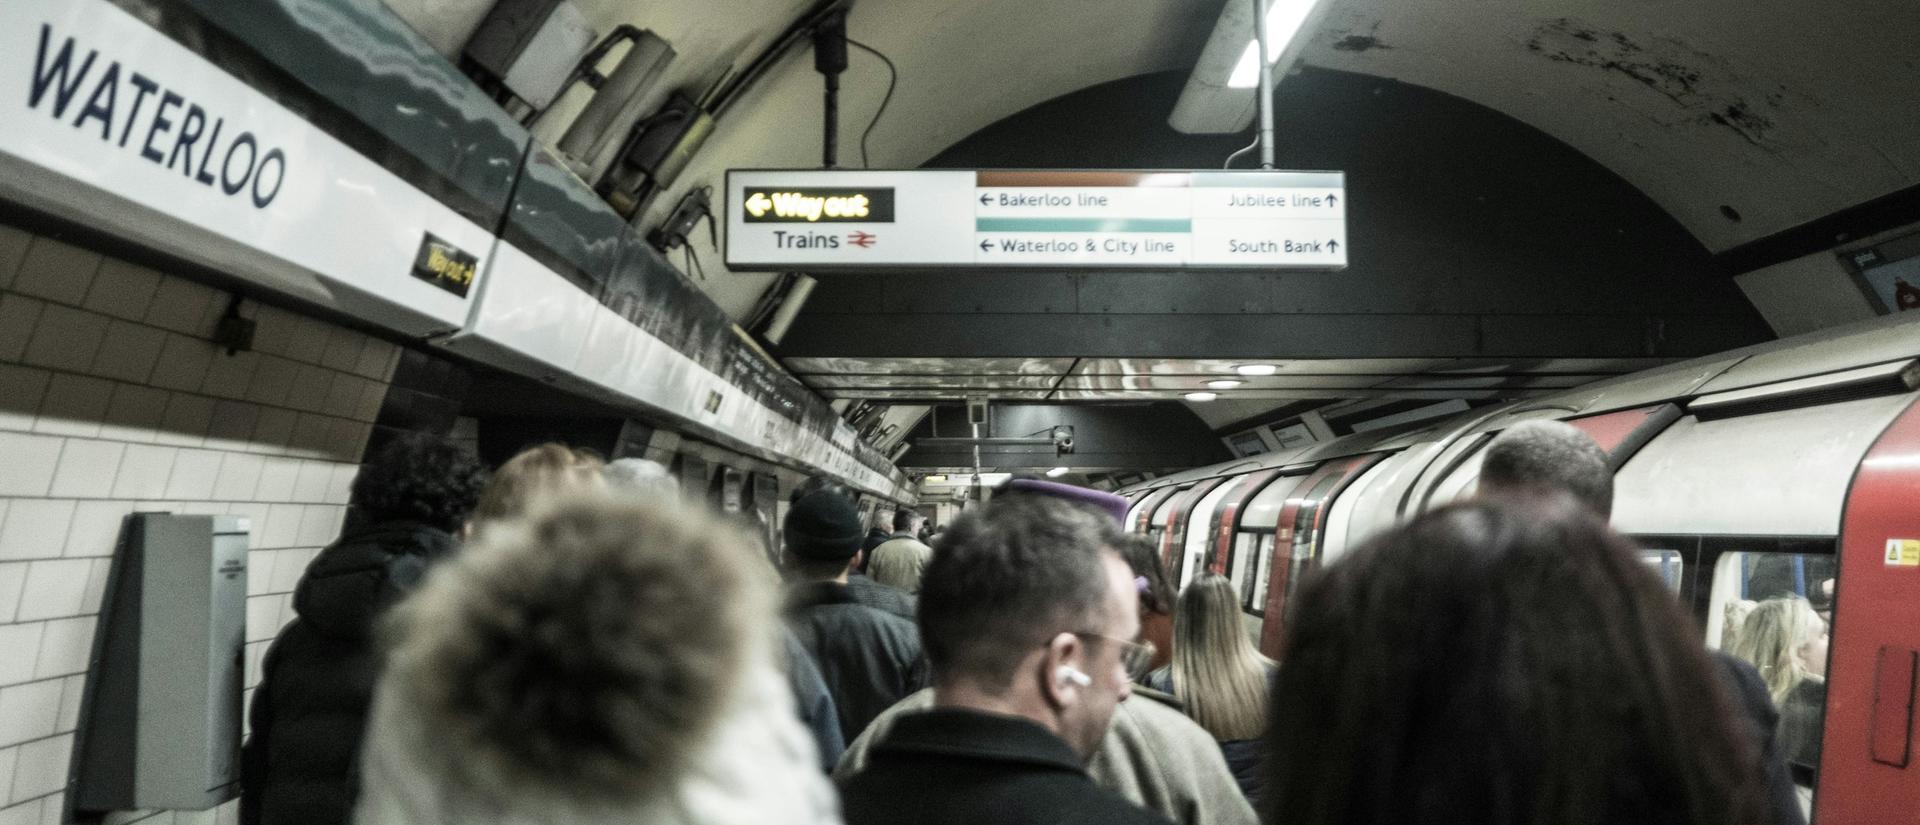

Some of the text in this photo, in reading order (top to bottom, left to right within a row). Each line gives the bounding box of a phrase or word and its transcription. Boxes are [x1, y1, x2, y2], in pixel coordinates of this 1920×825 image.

[27, 23, 286, 210] WATERLOO
[771, 192, 869, 221] Way out
[999, 193, 1108, 207] Bakerloo line
[1228, 194, 1322, 207] Jubilee line
[773, 230, 840, 249] Trains
[1000, 238, 1175, 255] Waterloo & City line
[1229, 239, 1322, 253] South Bank
